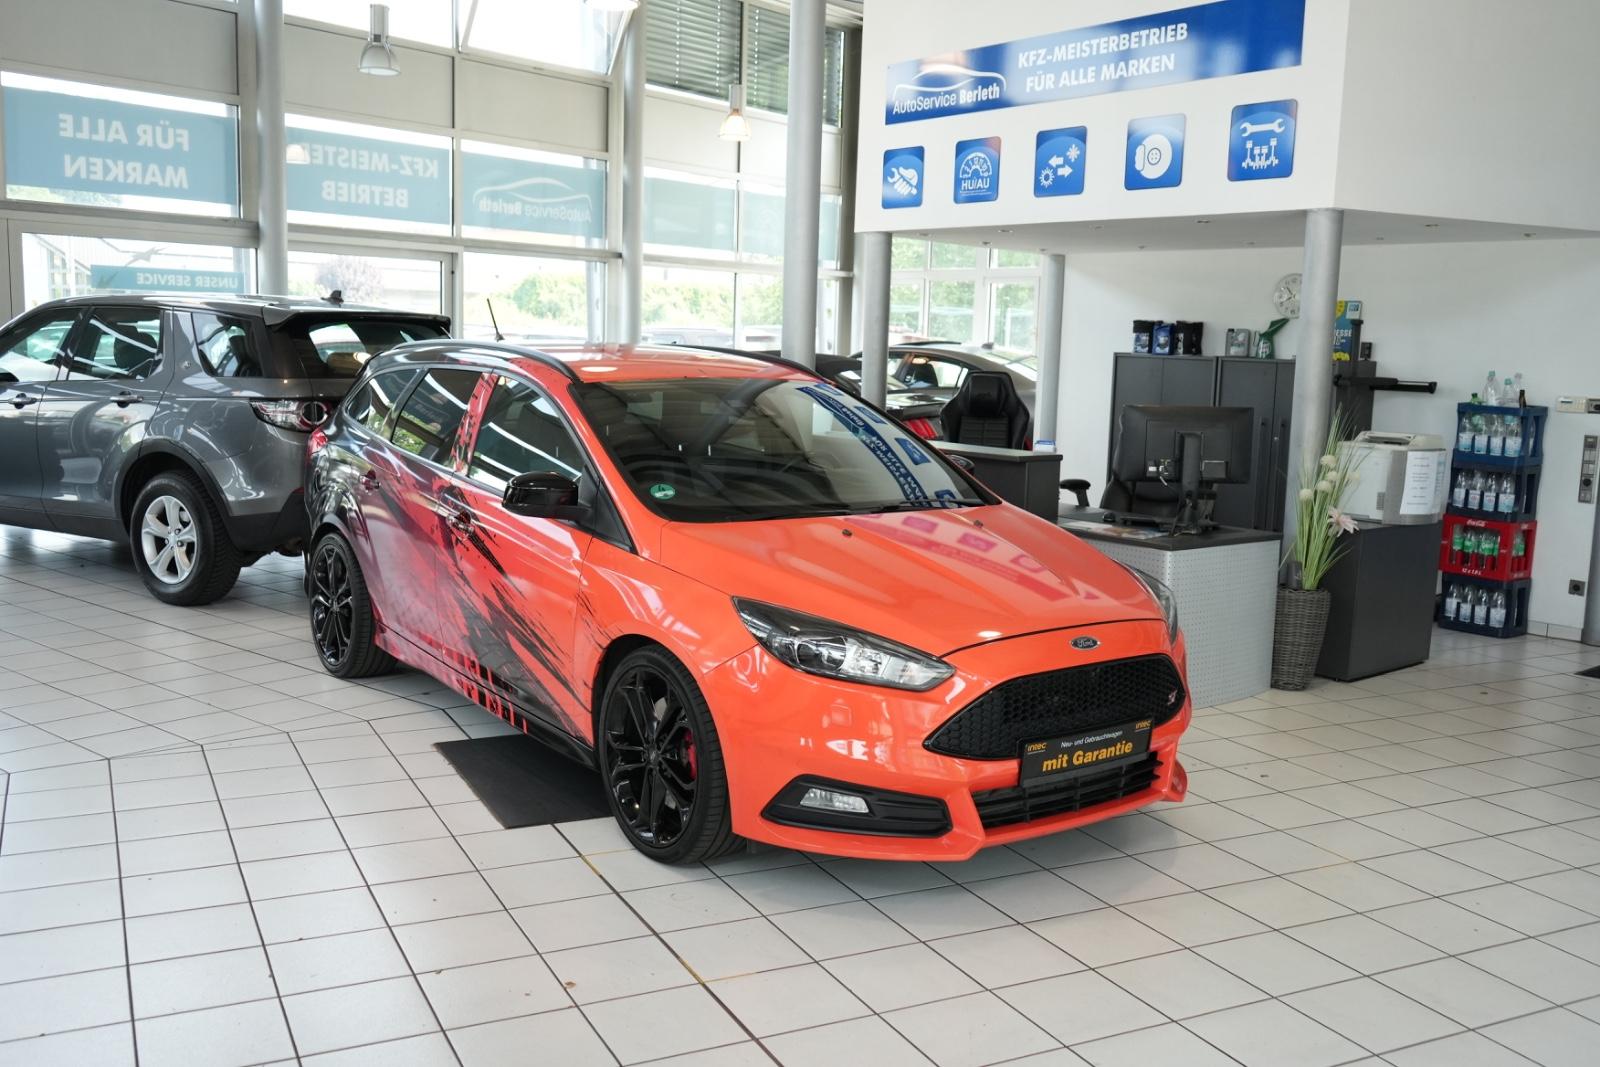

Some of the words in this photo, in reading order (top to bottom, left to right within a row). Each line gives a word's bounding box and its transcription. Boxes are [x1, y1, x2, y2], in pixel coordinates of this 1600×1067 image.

[1018, 22, 1188, 69] KFZ-MEISTERBETRIEB
[1025, 71, 1055, 93] FÜR
[1059, 66, 1096, 88] ALLE
[1100, 53, 1175, 81] MARKEN
[892, 92, 957, 115] AutoService
[959, 82, 1000, 104] Berleth
[961, 176, 990, 190] HU/AU
[1042, 754, 1069, 772] mit
[1072, 740, 1133, 765] Garantie
